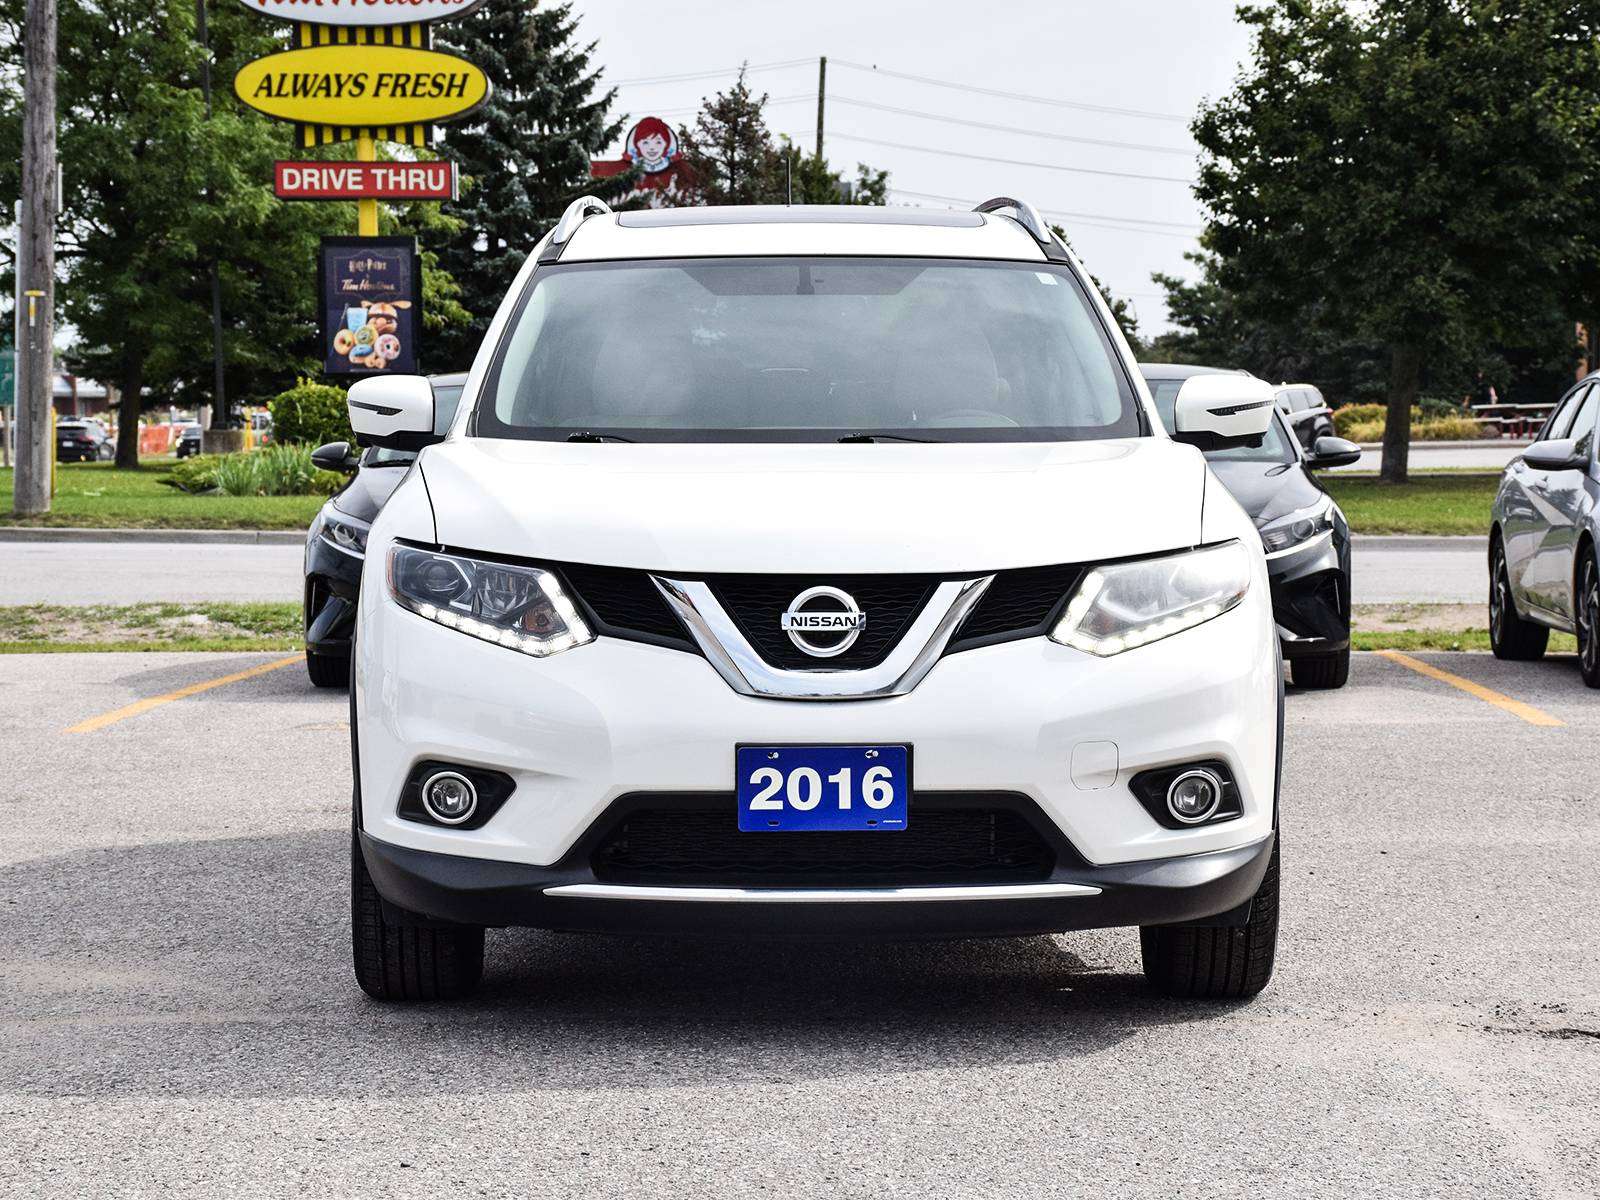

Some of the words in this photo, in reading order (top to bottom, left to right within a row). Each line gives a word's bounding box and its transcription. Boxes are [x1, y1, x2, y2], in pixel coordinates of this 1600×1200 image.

[253, 72, 369, 98] ALWAYS
[372, 73, 470, 98] FRESH
[282, 168, 364, 190] DRIVE
[370, 168, 445, 190] THRU
[790, 616, 857, 627] NISSAN
[749, 765, 894, 811] 2016
